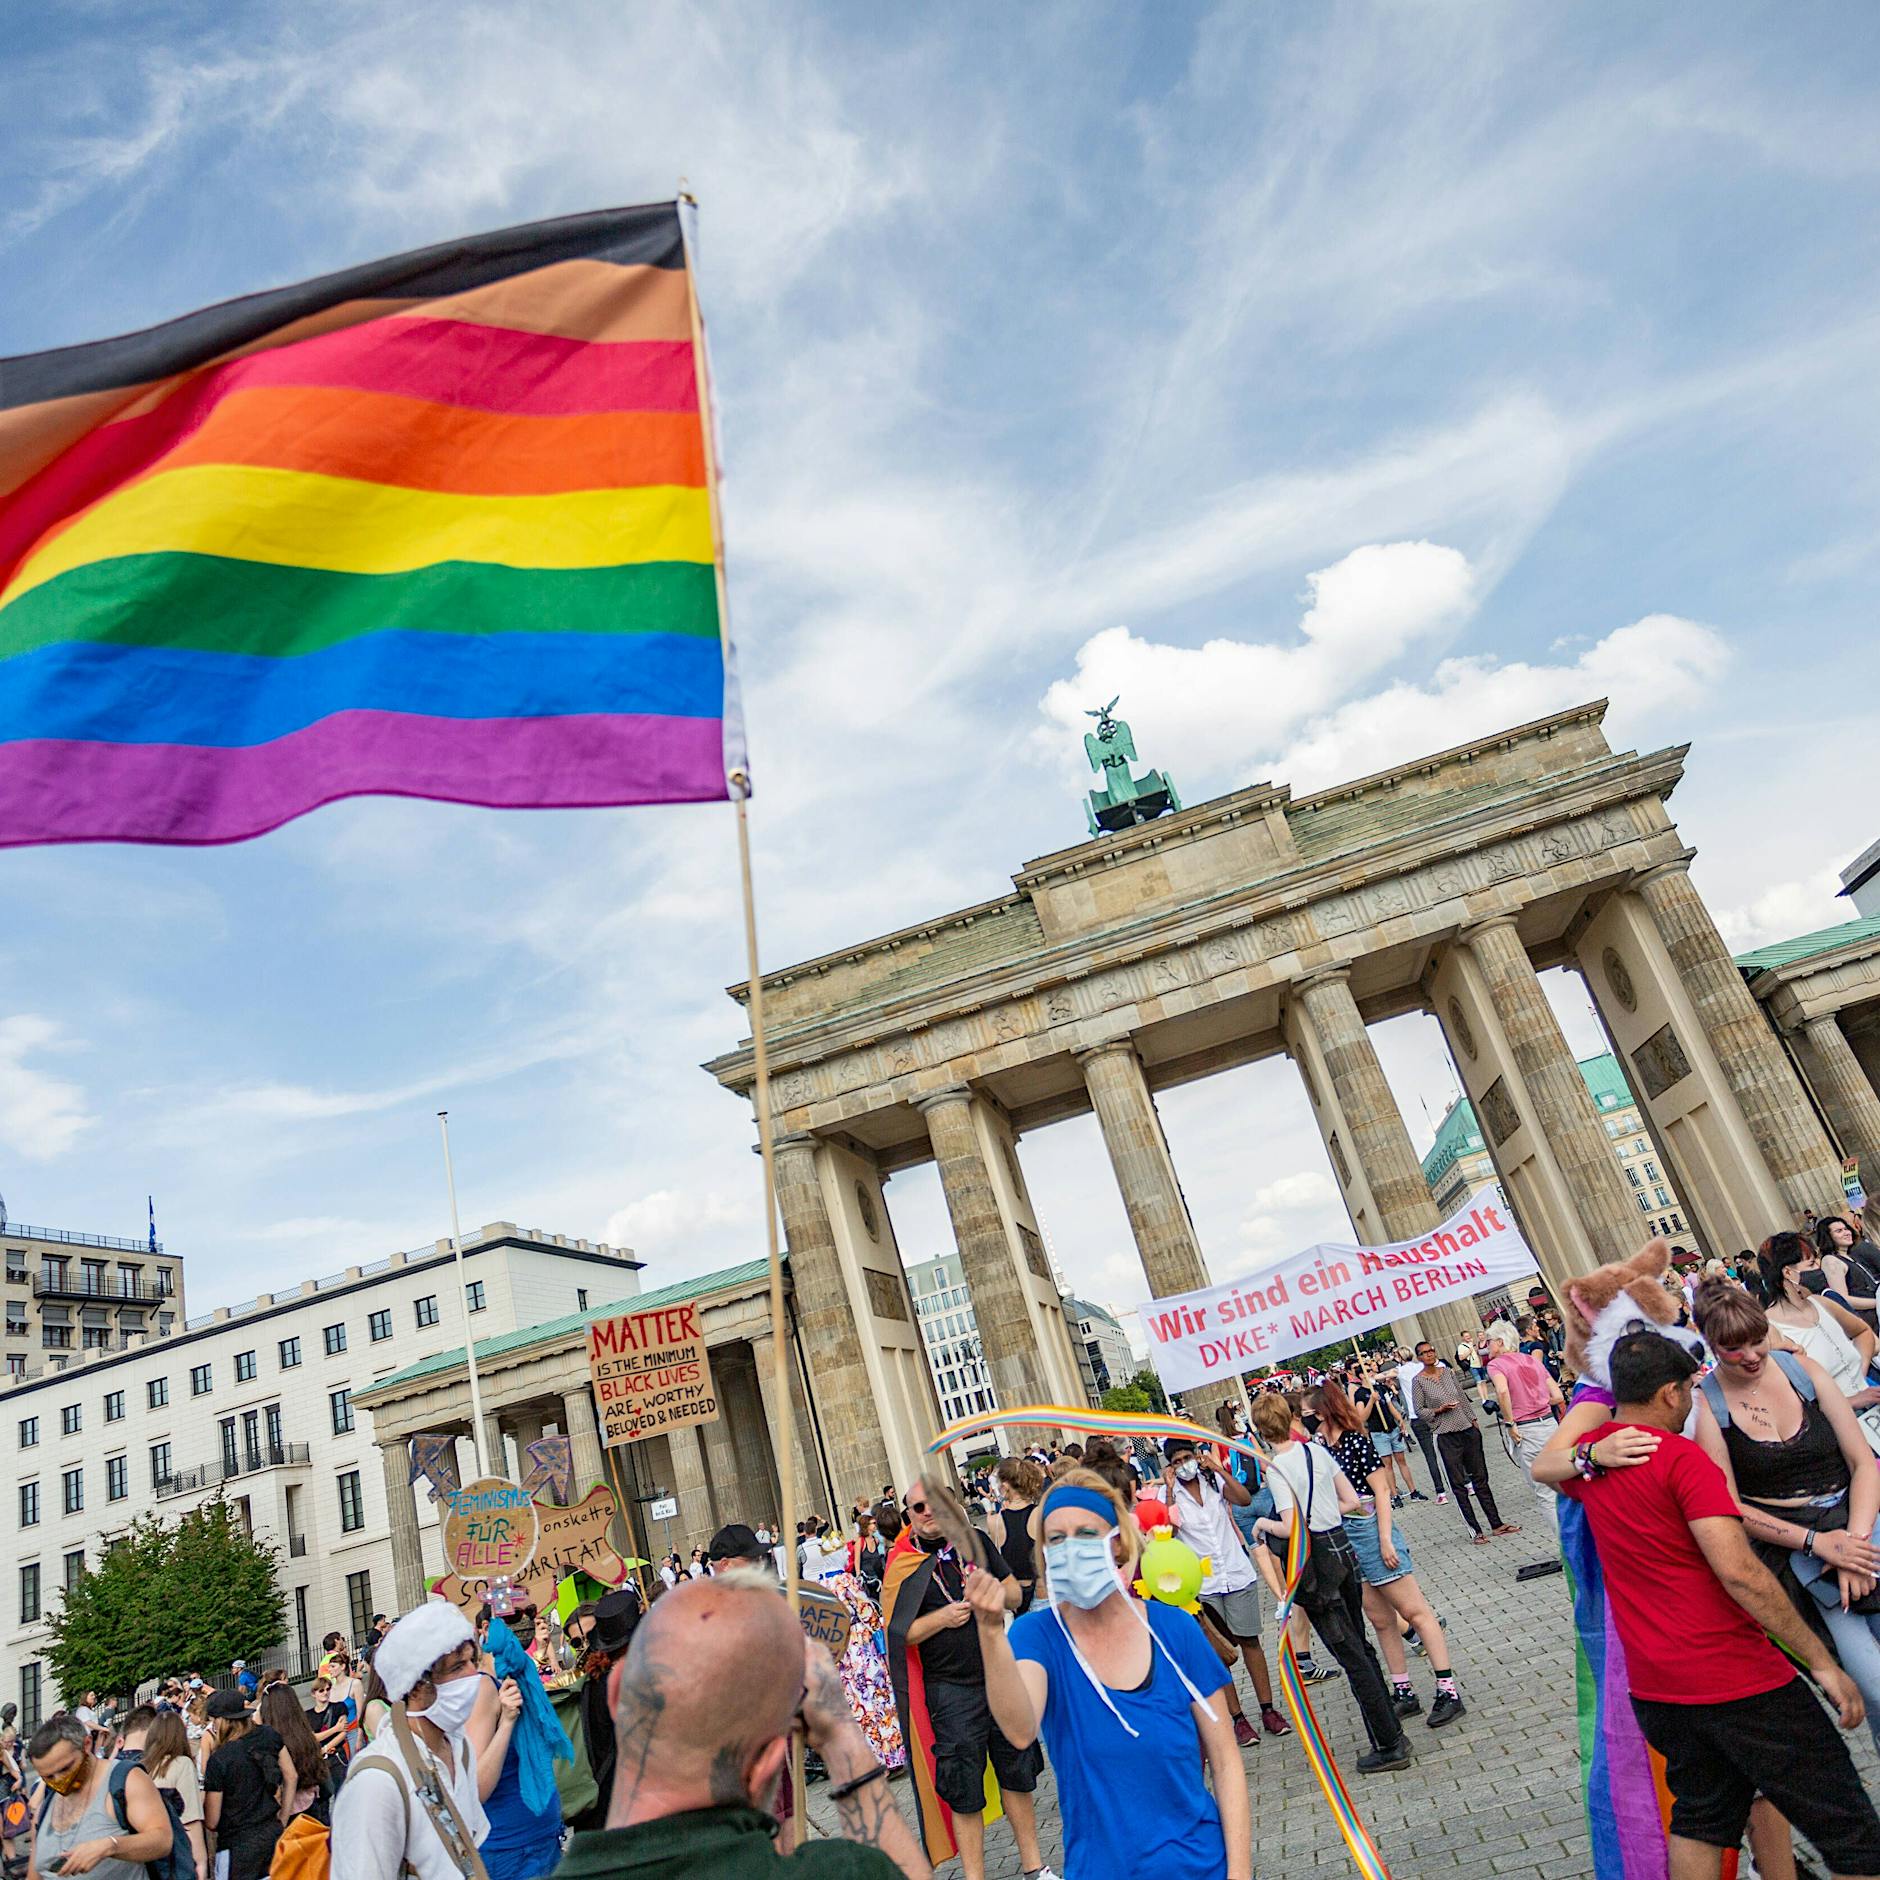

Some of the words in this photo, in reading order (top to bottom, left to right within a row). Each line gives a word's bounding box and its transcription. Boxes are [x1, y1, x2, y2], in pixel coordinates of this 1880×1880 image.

[1148, 1305, 1207, 1344] Wir
[1217, 1274, 1290, 1324] sind
[1298, 1260, 1351, 1296] ein
[1357, 1205, 1506, 1275] Haushalt
[1289, 1286, 1388, 1339] MARCH
[1392, 1258, 1488, 1303] BERLIN
[597, 1364, 611, 1377] IS
[612, 1357, 641, 1371] THE
[643, 1346, 696, 1368] MINIMUM
[600, 1374, 654, 1401] BLACK
[657, 1363, 700, 1387] LIVES
[605, 1400, 635, 1420] ARE
[643, 1384, 705, 1409] WORTHY
[606, 1414, 656, 1438] BELOVED
[657, 1410, 667, 1424] &
[669, 1398, 716, 1420] NEEDED
[447, 1488, 532, 1516] FEMINISMUS
[543, 1505, 614, 1533] onskette
[466, 1516, 510, 1543] FÜR
